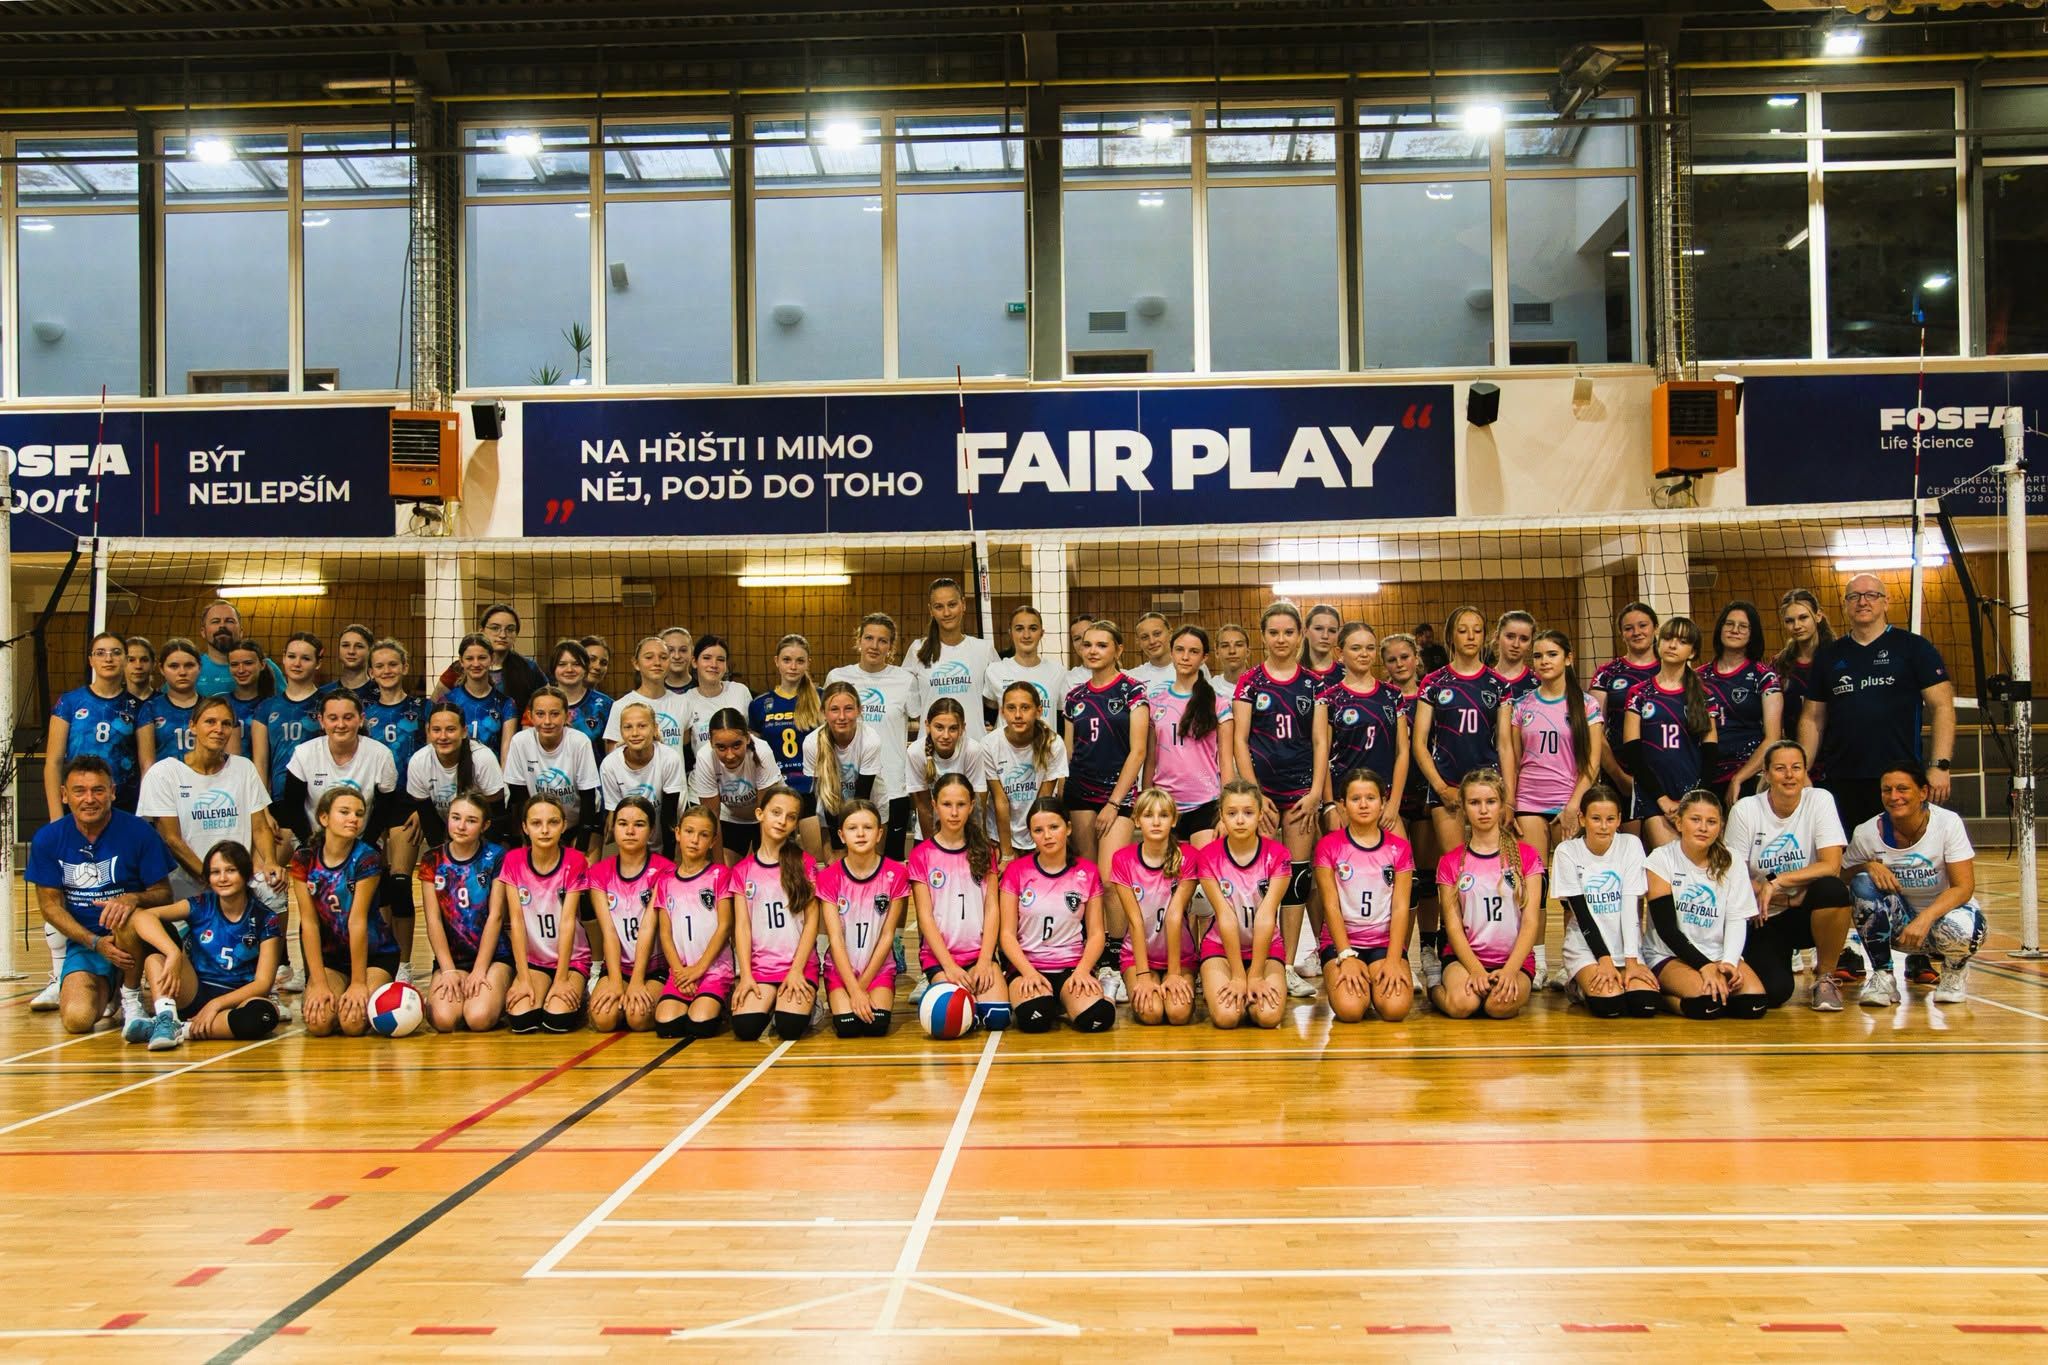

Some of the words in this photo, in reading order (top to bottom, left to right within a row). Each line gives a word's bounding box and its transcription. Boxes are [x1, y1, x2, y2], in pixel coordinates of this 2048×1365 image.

[581, 439, 629, 464] NA
[639, 432, 745, 463] HŘIŠTI
[758, 437, 764, 461] I
[777, 434, 873, 460] MIMO
[1881, 436, 1908, 449] Life
[1912, 435, 1974, 449] Science
[189, 445, 245, 473] BÝT
[957, 430, 1154, 494] FAIR
[1171, 425, 1394, 490] PLAY
[189, 475, 350, 505] NEJLEPŠÍM
[581, 471, 650, 506] NĚJ,
[662, 469, 752, 501] POJĎ
[764, 473, 815, 499] DO
[823, 471, 923, 498] TOHO
[2025, 494, 2044, 503] 028
[929, 676, 972, 687] VOLLEYBALL
[1861, 676, 1884, 690] plus
[765, 712, 794, 722] FOS
[1276, 713, 1292, 739] 31
[1458, 708, 1478, 734] 70
[96, 722, 110, 743] 8
[174, 728, 196, 750] 16
[282, 722, 302, 741] 10
[384, 724, 397, 743] 6
[1090, 718, 1099, 742] 5
[1539, 730, 1558, 755] 70
[1661, 724, 1680, 749] 12
[782, 728, 798, 758] 8
[191, 807, 239, 820] VOLLEYBALL
[328, 894, 342, 913] 2
[457, 887, 469, 908] 9
[1360, 891, 1372, 917] 5
[1483, 896, 1503, 922] 12
[1675, 901, 1719, 918] VOLLEYBALL
[537, 914, 556, 939] 19
[765, 901, 785, 929] 16
[1155, 908, 1165, 933] 9
[623, 917, 640, 942] 18
[685, 915, 693, 941] 1
[856, 922, 869, 948] 17
[1043, 916, 1054, 941] 6
[221, 947, 234, 970] 5
